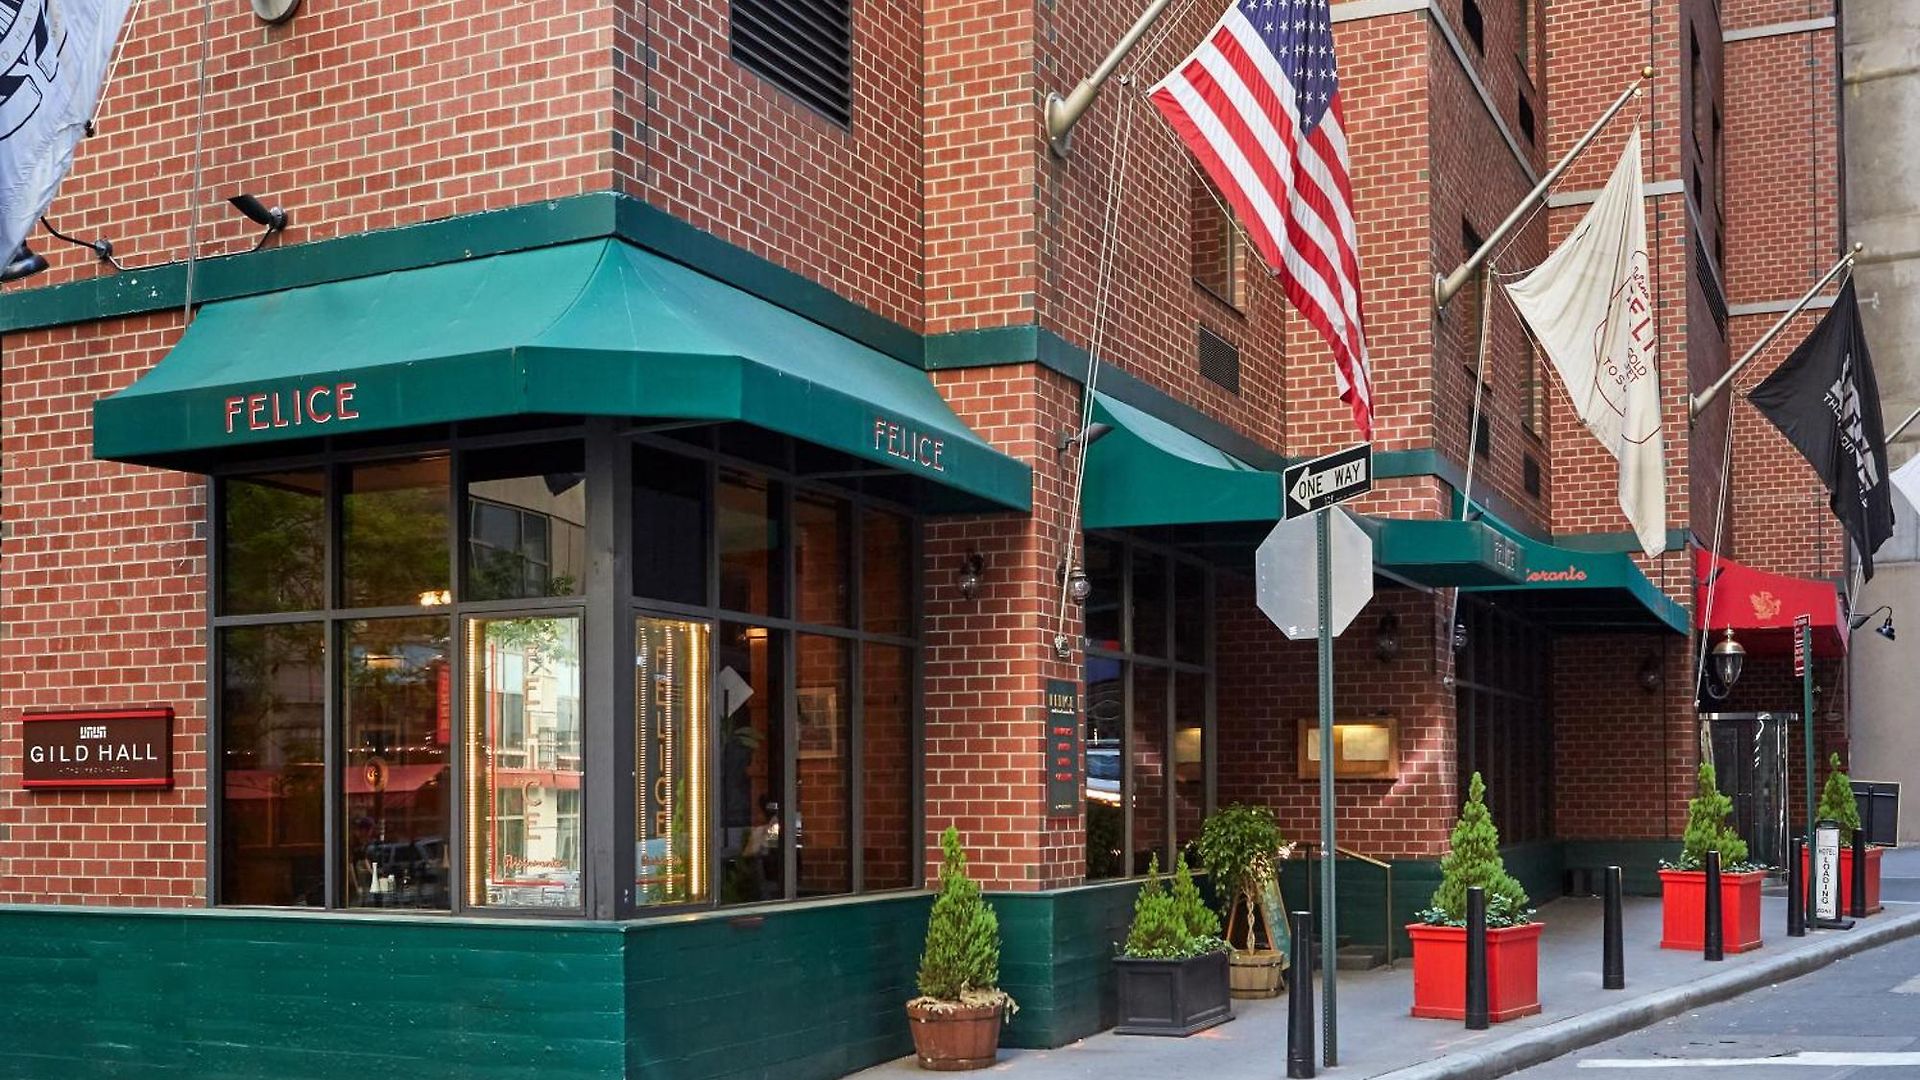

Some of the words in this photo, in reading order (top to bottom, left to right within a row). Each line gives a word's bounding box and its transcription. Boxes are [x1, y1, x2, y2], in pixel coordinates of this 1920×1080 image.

[225, 382, 359, 433] FELICE
[874, 417, 945, 472] FELICE
[1298, 475, 1323, 500] ONE
[1334, 461, 1361, 488] WAY
[30, 744, 90, 763] GILD
[99, 742, 158, 761] HALL
[1821, 856, 1830, 904] LOADING
